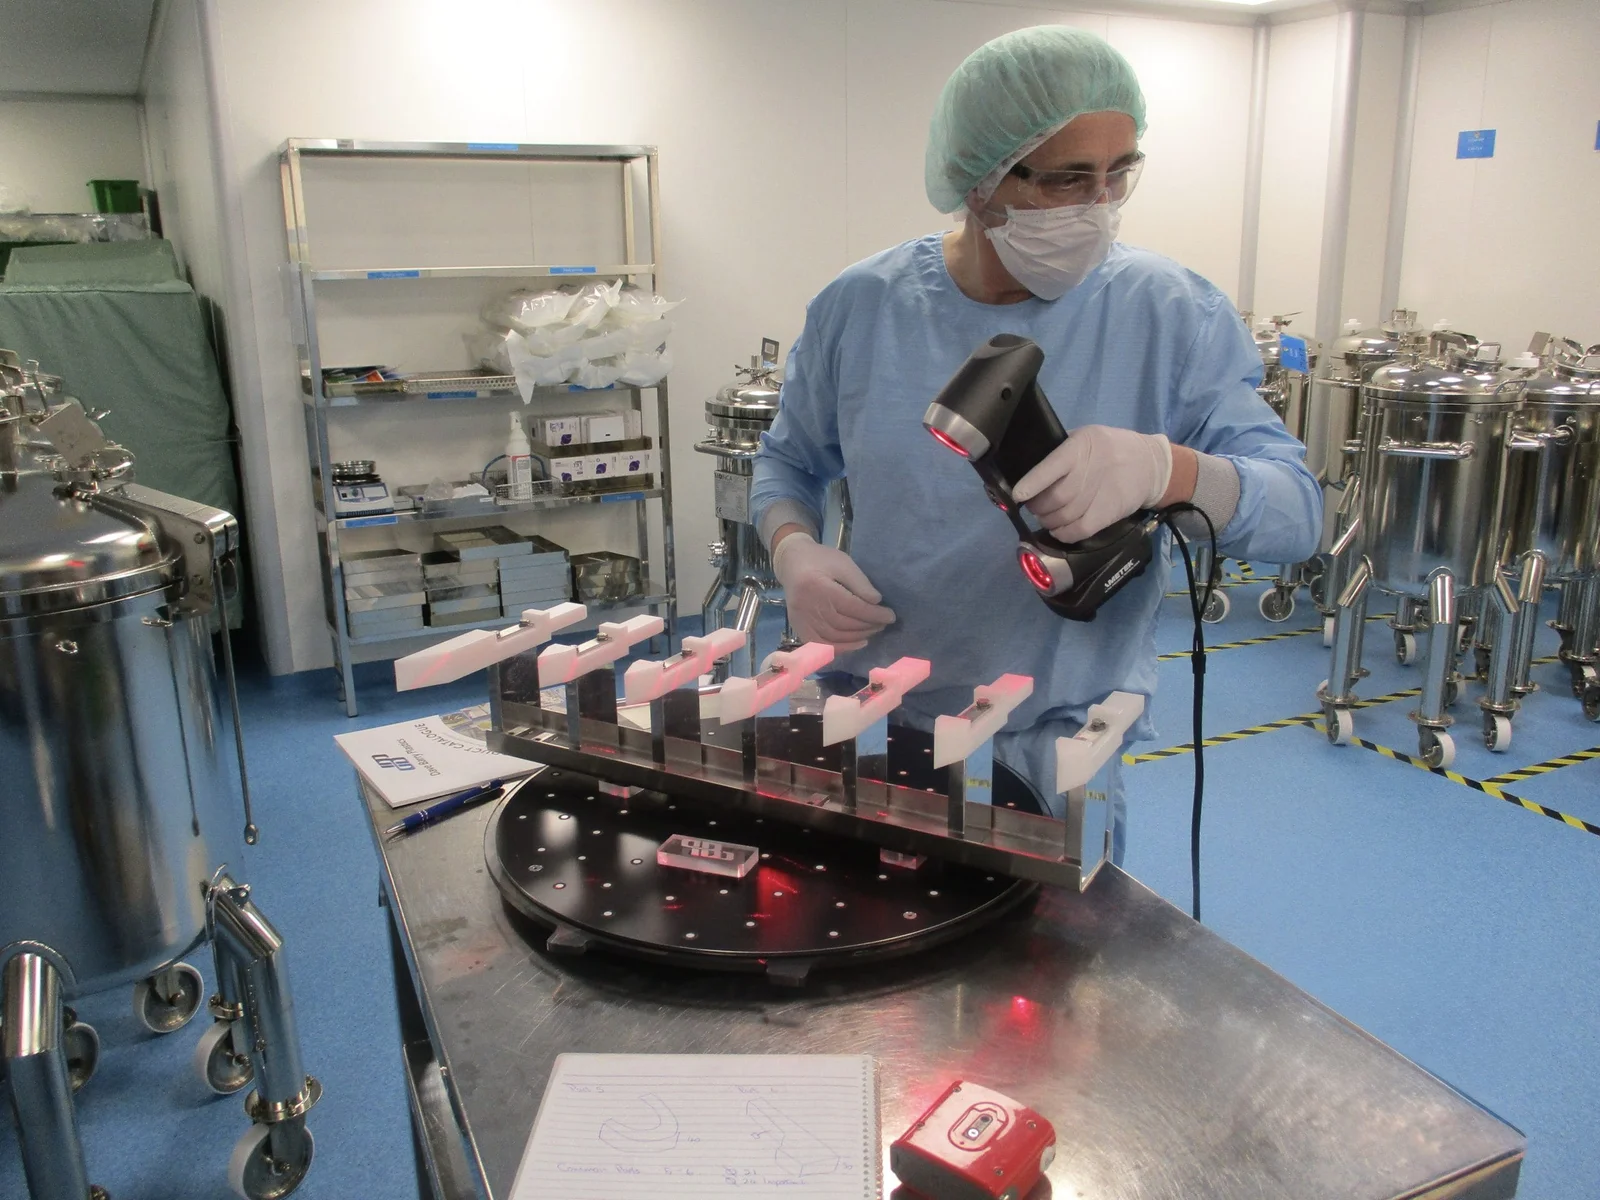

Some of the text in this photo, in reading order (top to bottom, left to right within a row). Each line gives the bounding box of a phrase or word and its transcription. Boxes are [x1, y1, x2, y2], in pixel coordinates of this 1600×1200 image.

[1104, 558, 1134, 588] AMETEK
[414, 723, 465, 749] CATALOGUE
[396, 738, 441, 777] Dave Barry Plastics
